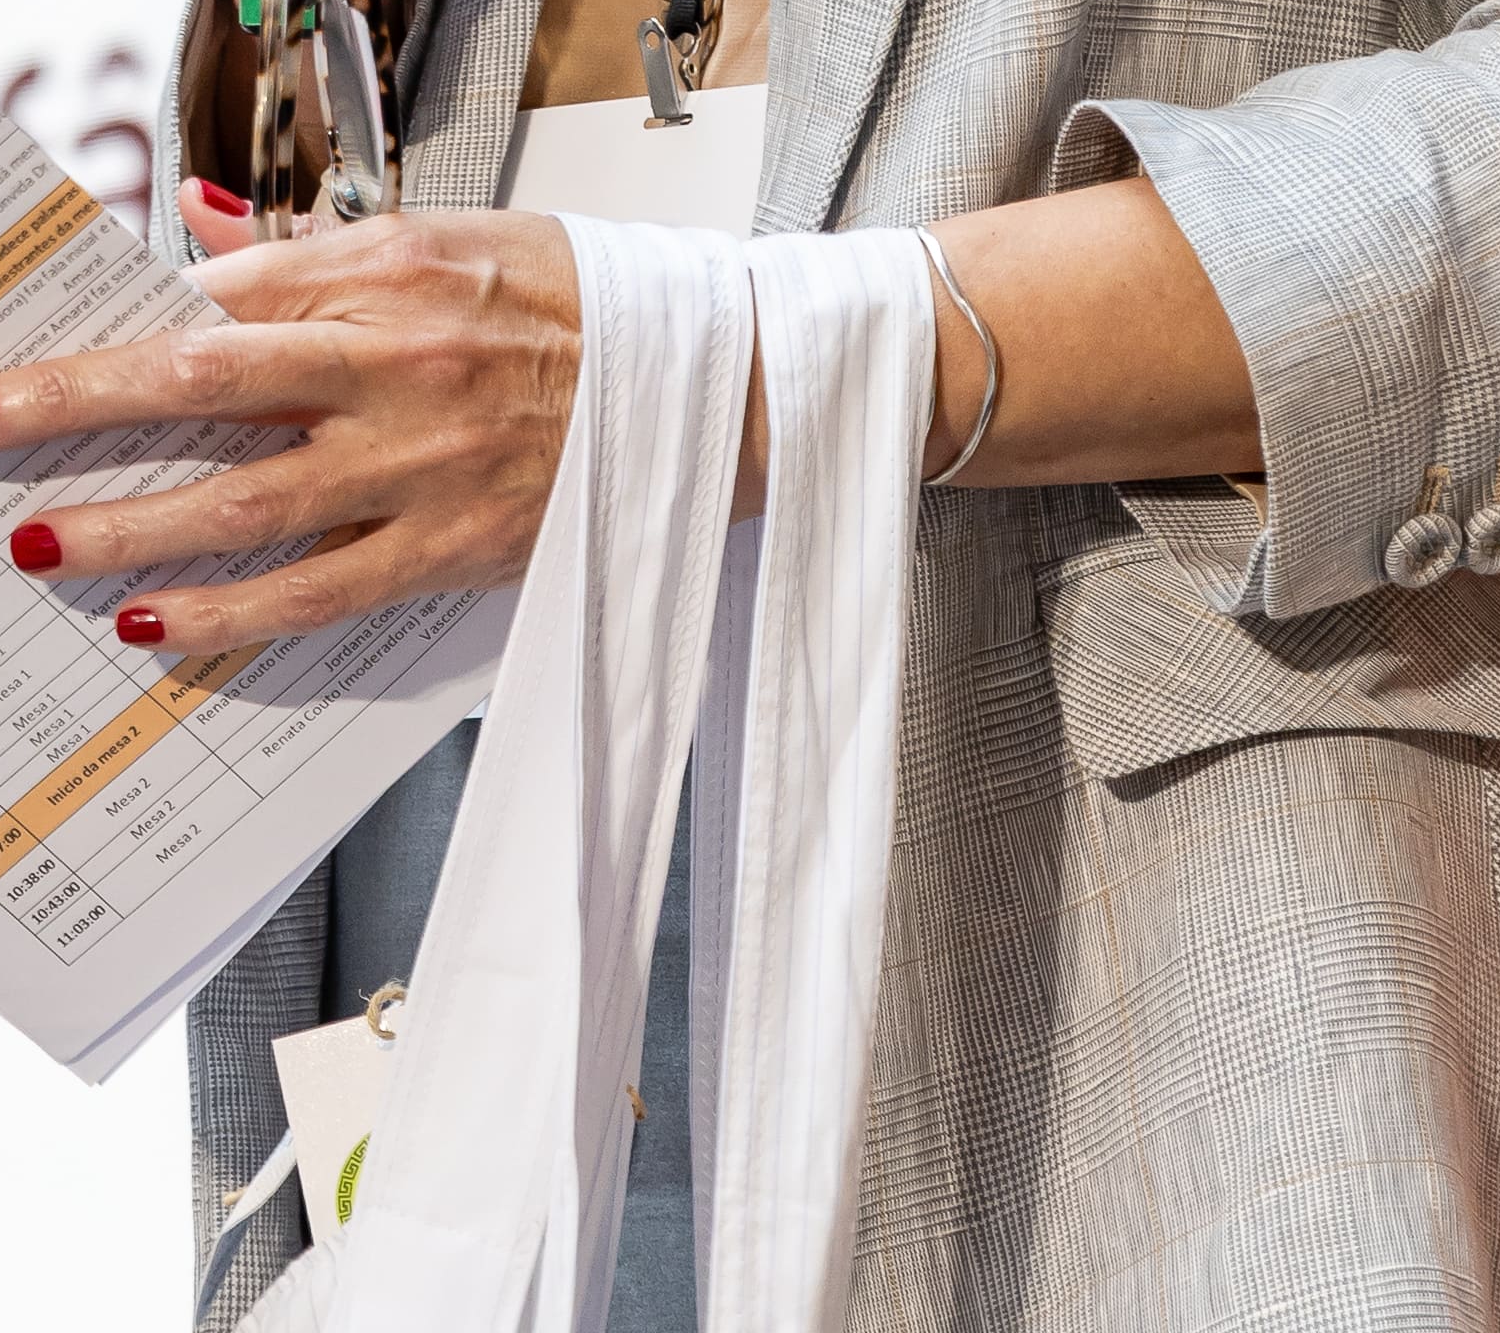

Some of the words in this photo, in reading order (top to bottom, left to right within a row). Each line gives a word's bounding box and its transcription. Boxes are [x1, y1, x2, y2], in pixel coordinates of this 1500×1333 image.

[55, 221, 74, 238] da
[22, 278, 46, 297] faz
[40, 260, 69, 282] fala
[62, 229, 100, 264] inicial
[99, 223, 111, 235] e
[62, 252, 106, 294] Amaral
[49, 294, 94, 335] Amaral
[89, 281, 113, 300] faz
[110, 262, 135, 285] sua
[89, 300, 145, 354] agradece
[142, 292, 155, 303] e
[110, 436, 145, 466] Lilian
[223, 438, 248, 459] faz
[23, 451, 70, 492] Kalvon
[84, 587, 128, 623] Marcia
[417, 585, 480, 641] Vasconce
[323, 628, 374, 673] Jordana
[20, 669, 33, 680] 1
[169, 673, 200, 704] Ana
[193, 652, 230, 684] sobre
[195, 682, 245, 726] Renata
[237, 657, 277, 690] Couto
[261, 720, 307, 758] Renata
[303, 683, 346, 722] Couto
[337, 614, 422, 692] (moderadora)
[11, 701, 49, 733] Mesa
[45, 692, 58, 704] 1
[28, 717, 66, 748] Mesa
[62, 708, 75, 720] 1
[45, 733, 84, 764] Mesa
[79, 724, 92, 736] 1
[82, 762, 100, 779] da
[96, 735, 133, 766] mesa
[127, 725, 142, 738] 2
[104, 786, 143, 818] Mesa
[137, 777, 152, 790] 2
[129, 809, 167, 841] Mesa
[162, 799, 177, 812] 2
[154, 833, 193, 865] Mesa
[187, 823, 203, 836] 2
[6, 858, 56, 903] 10:38:00
[31, 881, 81, 925] 10:43:00
[56, 904, 107, 948] 11:03:00
